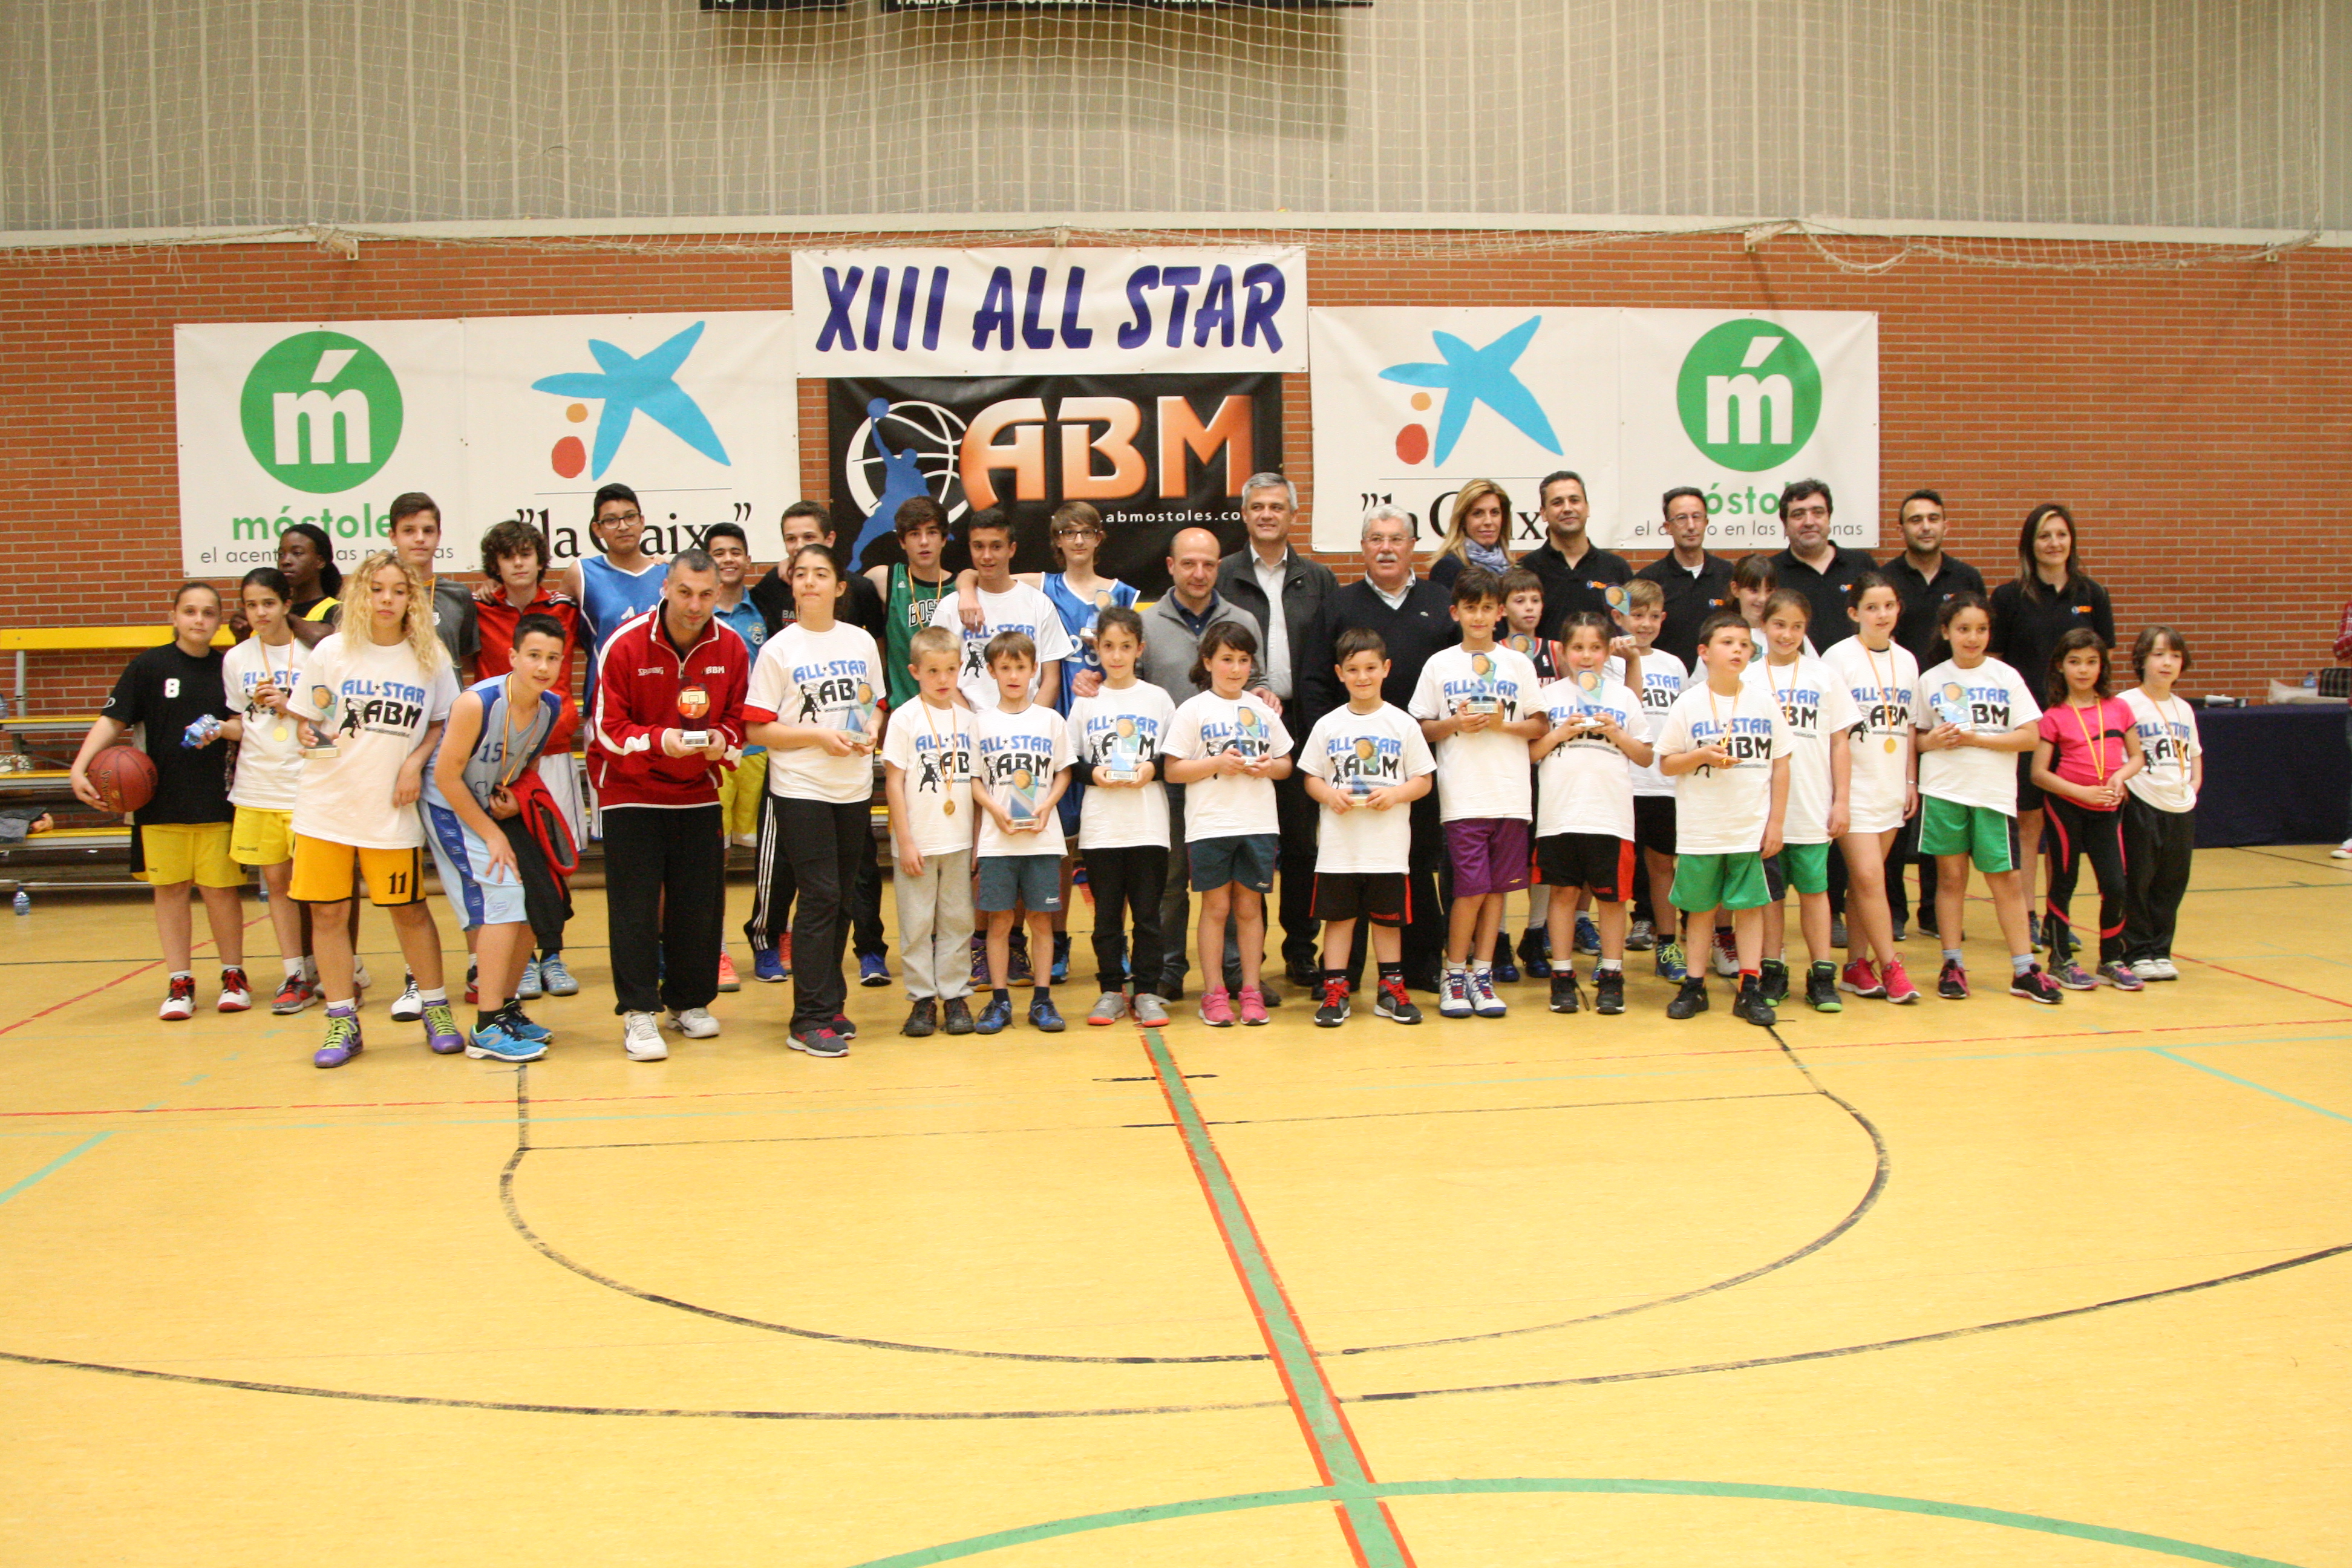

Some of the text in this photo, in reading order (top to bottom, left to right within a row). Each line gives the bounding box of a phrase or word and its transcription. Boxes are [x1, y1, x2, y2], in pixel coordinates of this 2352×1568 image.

[815, 263, 1286, 354] XIII ALL STAR
[959, 395, 1254, 512] ABM
[233, 503, 391, 540] mótole
[1635, 520, 1650, 536] el
[1725, 524, 1745, 536] en
[1753, 520, 1776, 536] las
[201, 546, 217, 563] el
[226, 547, 279, 563] acent
[336, 549, 357, 561] as
[792, 659, 867, 684] ALL STAR
[165, 678, 180, 698] 8
[342, 679, 426, 706] ALL STAR
[819, 678, 861, 706] AB
[1444, 679, 1472, 699] ALL
[1777, 688, 1820, 707] STAR
[1851, 687, 1878, 702] ALL
[1967, 687, 2011, 705] STAR
[364, 699, 423, 729] ABM
[1086, 714, 1111, 736] ALL
[1782, 705, 1817, 730] BM
[1971, 704, 2010, 726] BM
[1201, 722, 1230, 742] ALL
[1691, 717, 1772, 739] ALL STAR
[480, 742, 503, 763] 15
[916, 733, 946, 753] ALL
[979, 734, 1053, 756] ALL STAR
[1327, 736, 1353, 756] ALL
[939, 751, 970, 776] AB
[388, 871, 407, 894] 11
